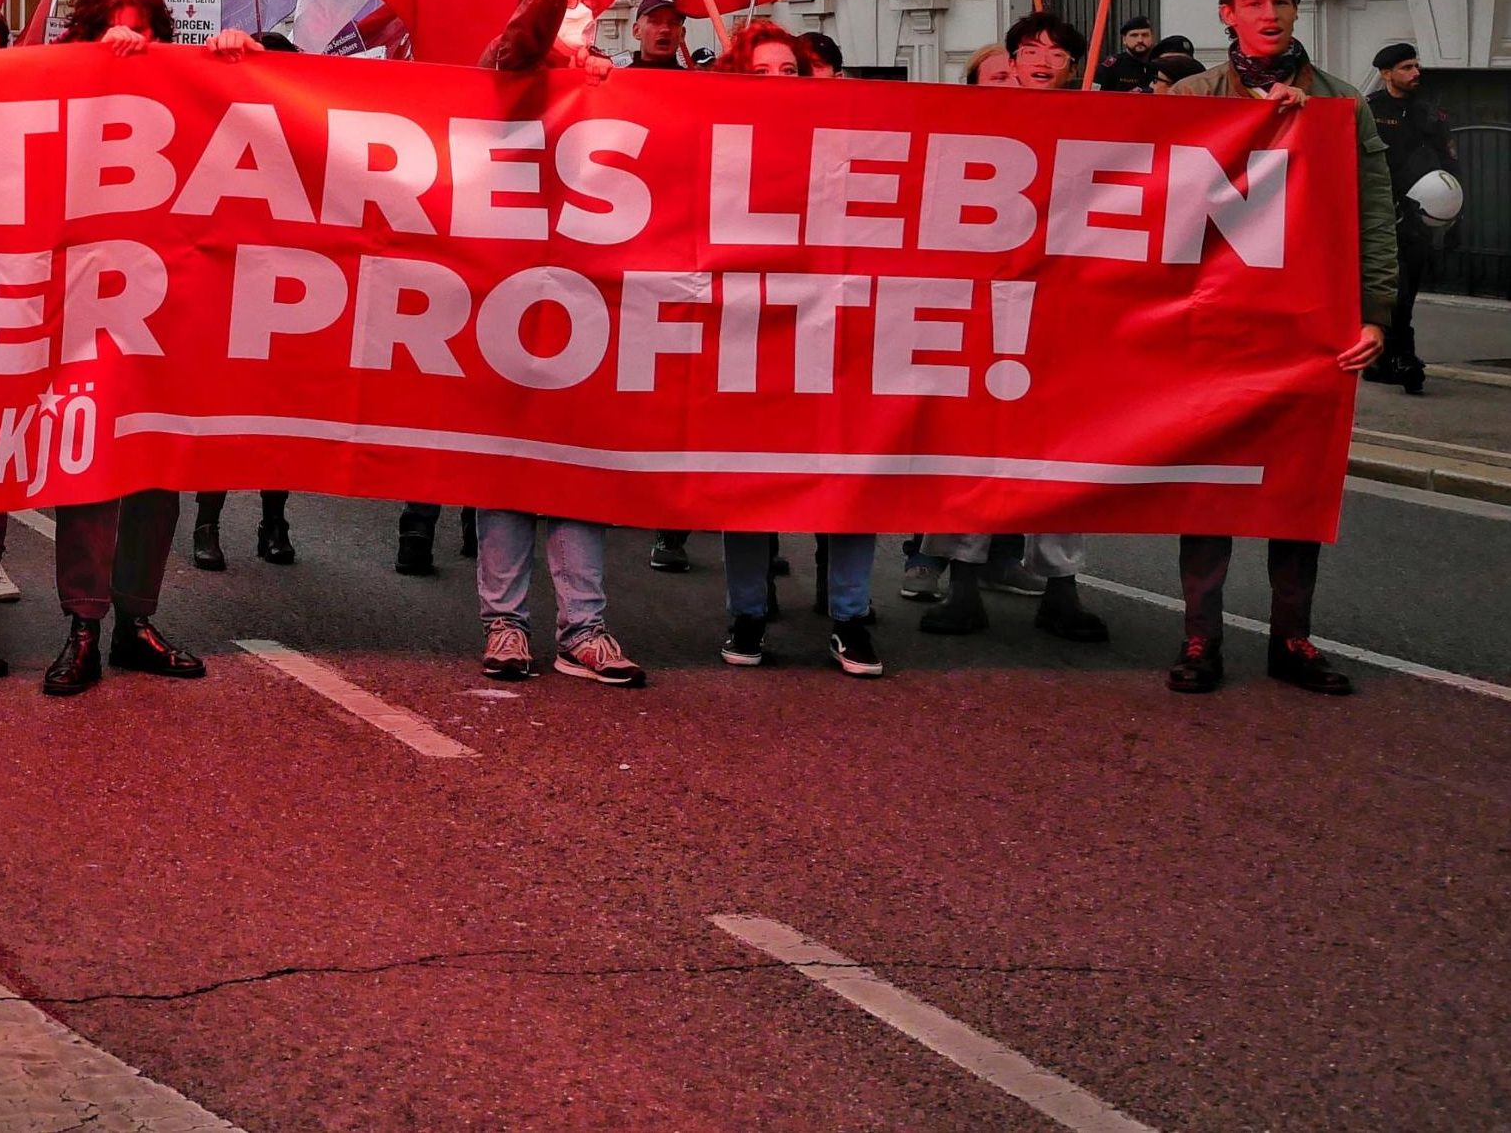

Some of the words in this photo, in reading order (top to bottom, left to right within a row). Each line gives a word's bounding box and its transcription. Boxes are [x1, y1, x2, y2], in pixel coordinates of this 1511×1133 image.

[173, 19, 215, 31] ORGEN:
[709, 123, 1289, 269] LEBEN
[227, 243, 1038, 403] PROFITE!
